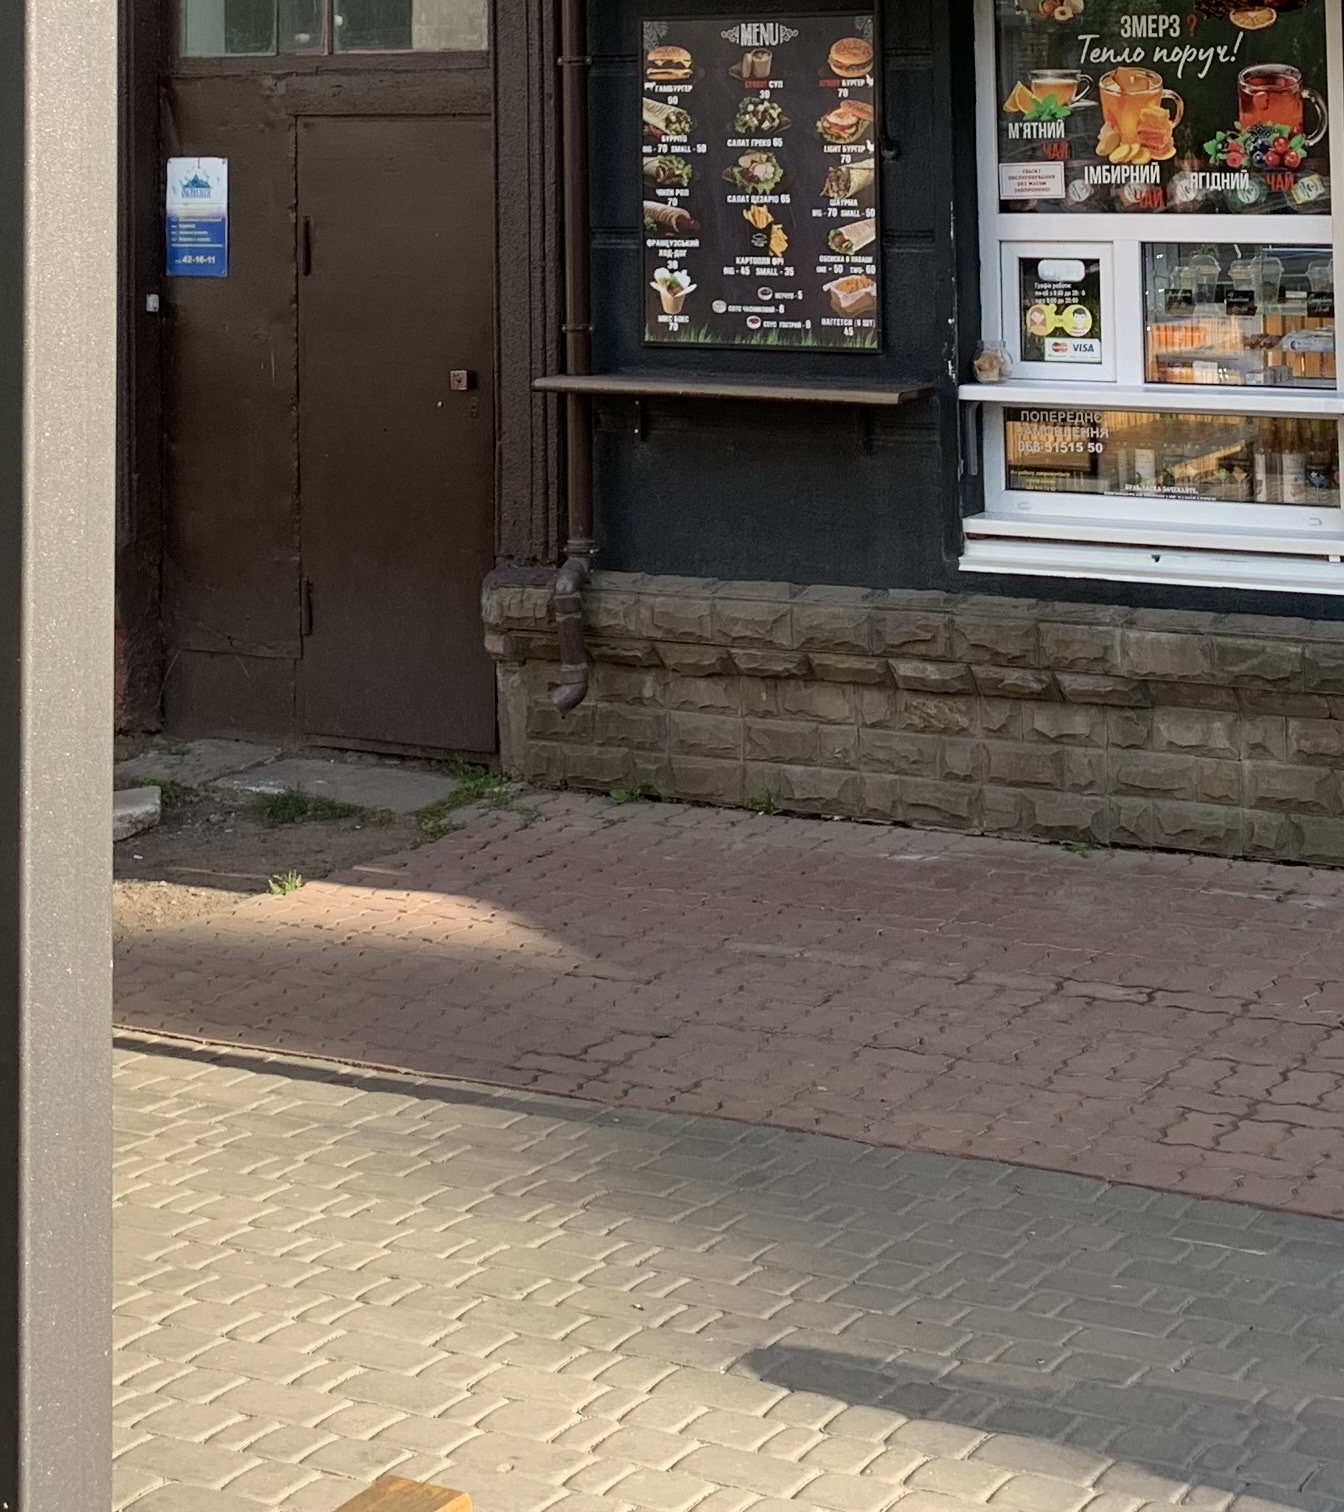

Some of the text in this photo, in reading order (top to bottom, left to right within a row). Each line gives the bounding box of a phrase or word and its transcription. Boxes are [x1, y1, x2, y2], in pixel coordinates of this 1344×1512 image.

[1120, 14, 1181, 39] ЗМЕРЗ
[740, 23, 779, 47] MENU
[1077, 31, 1244, 79] Тепло поруч!
[838, 88, 849, 98] 70
[1008, 119, 1065, 139] М'ЯТНИЙ
[726, 138, 750, 147] САЛАТ
[657, 144, 668, 153] 70
[840, 154, 852, 164] 70
[1084, 162, 1161, 186] ІМБИРНИЙ
[1190, 171, 1295, 191] ЯГІДНИЙ ЧАЙ
[667, 197, 678, 207] 70
[726, 195, 750, 204] САЛАТ
[827, 208, 838, 218] 70
[668, 322, 679, 332] 70
[1072, 343, 1095, 353] VISA
[1087, 442, 1104, 453] 50
